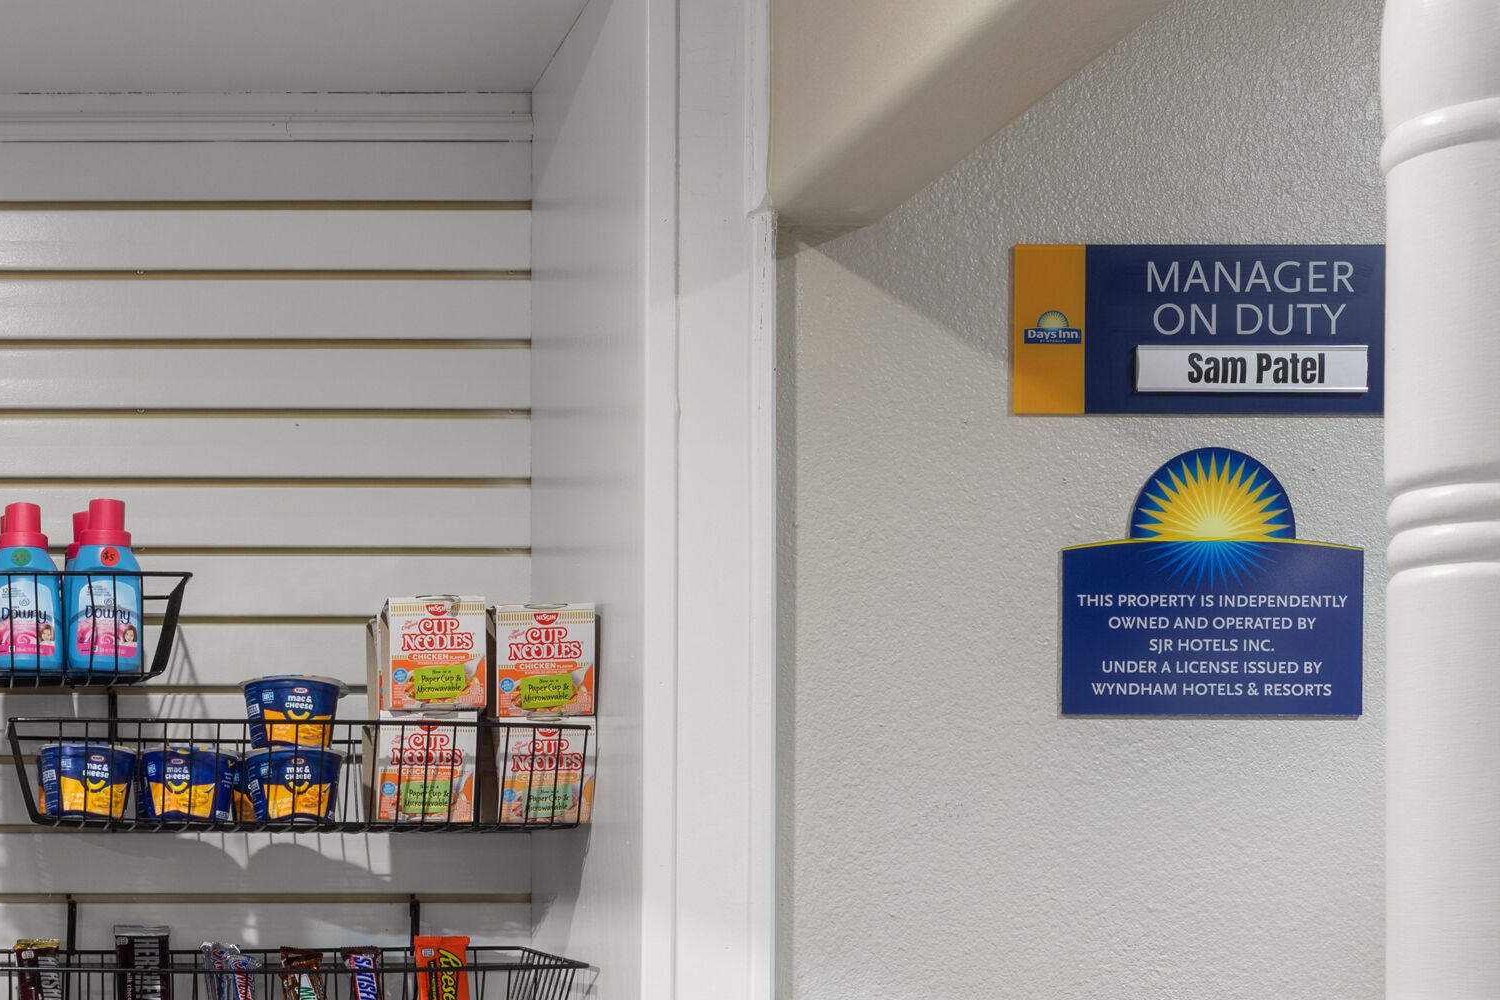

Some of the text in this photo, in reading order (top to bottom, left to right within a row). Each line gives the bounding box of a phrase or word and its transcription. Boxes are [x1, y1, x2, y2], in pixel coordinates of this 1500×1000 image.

[1147, 260, 1355, 293] MANAGER
[1153, 303, 1347, 336] ON DUTY
[1027, 329, 1079, 340] Days Inn
[1187, 352, 1325, 384] Sam Patel
[103, 550, 115, 562] $5
[1077, 594, 1348, 608] THIS PROPERTY IS INDEPENDENTLY
[536, 613, 557, 622] NISSIN
[1108, 616, 1316, 630] OWNED AND OPERATED BY
[418, 617, 460, 635] CUP
[401, 632, 474, 652] NOODLES
[525, 627, 568, 644] CUP
[508, 641, 582, 661] NOODLES
[1149, 638, 1275, 654] SJR HOTELS INC.
[1102, 660, 1322, 674] UNDER A LICENSE ISSUED BY
[421, 675, 441, 684] Paper
[441, 675, 454, 683] Cup
[416, 685, 461, 694] Microwavable
[528, 684, 547, 693] Paper
[547, 683, 561, 692] Cup
[1092, 682, 1332, 696] WYNDHAM HOTELS & RESORTS
[523, 693, 568, 703] Microwavable
[408, 733, 450, 750] CUP
[528, 739, 570, 755] CUP
[391, 747, 463, 767] NOODLES
[86, 763, 109, 771] mac &
[182, 765, 189, 773] &
[428, 789, 442, 798] Cup
